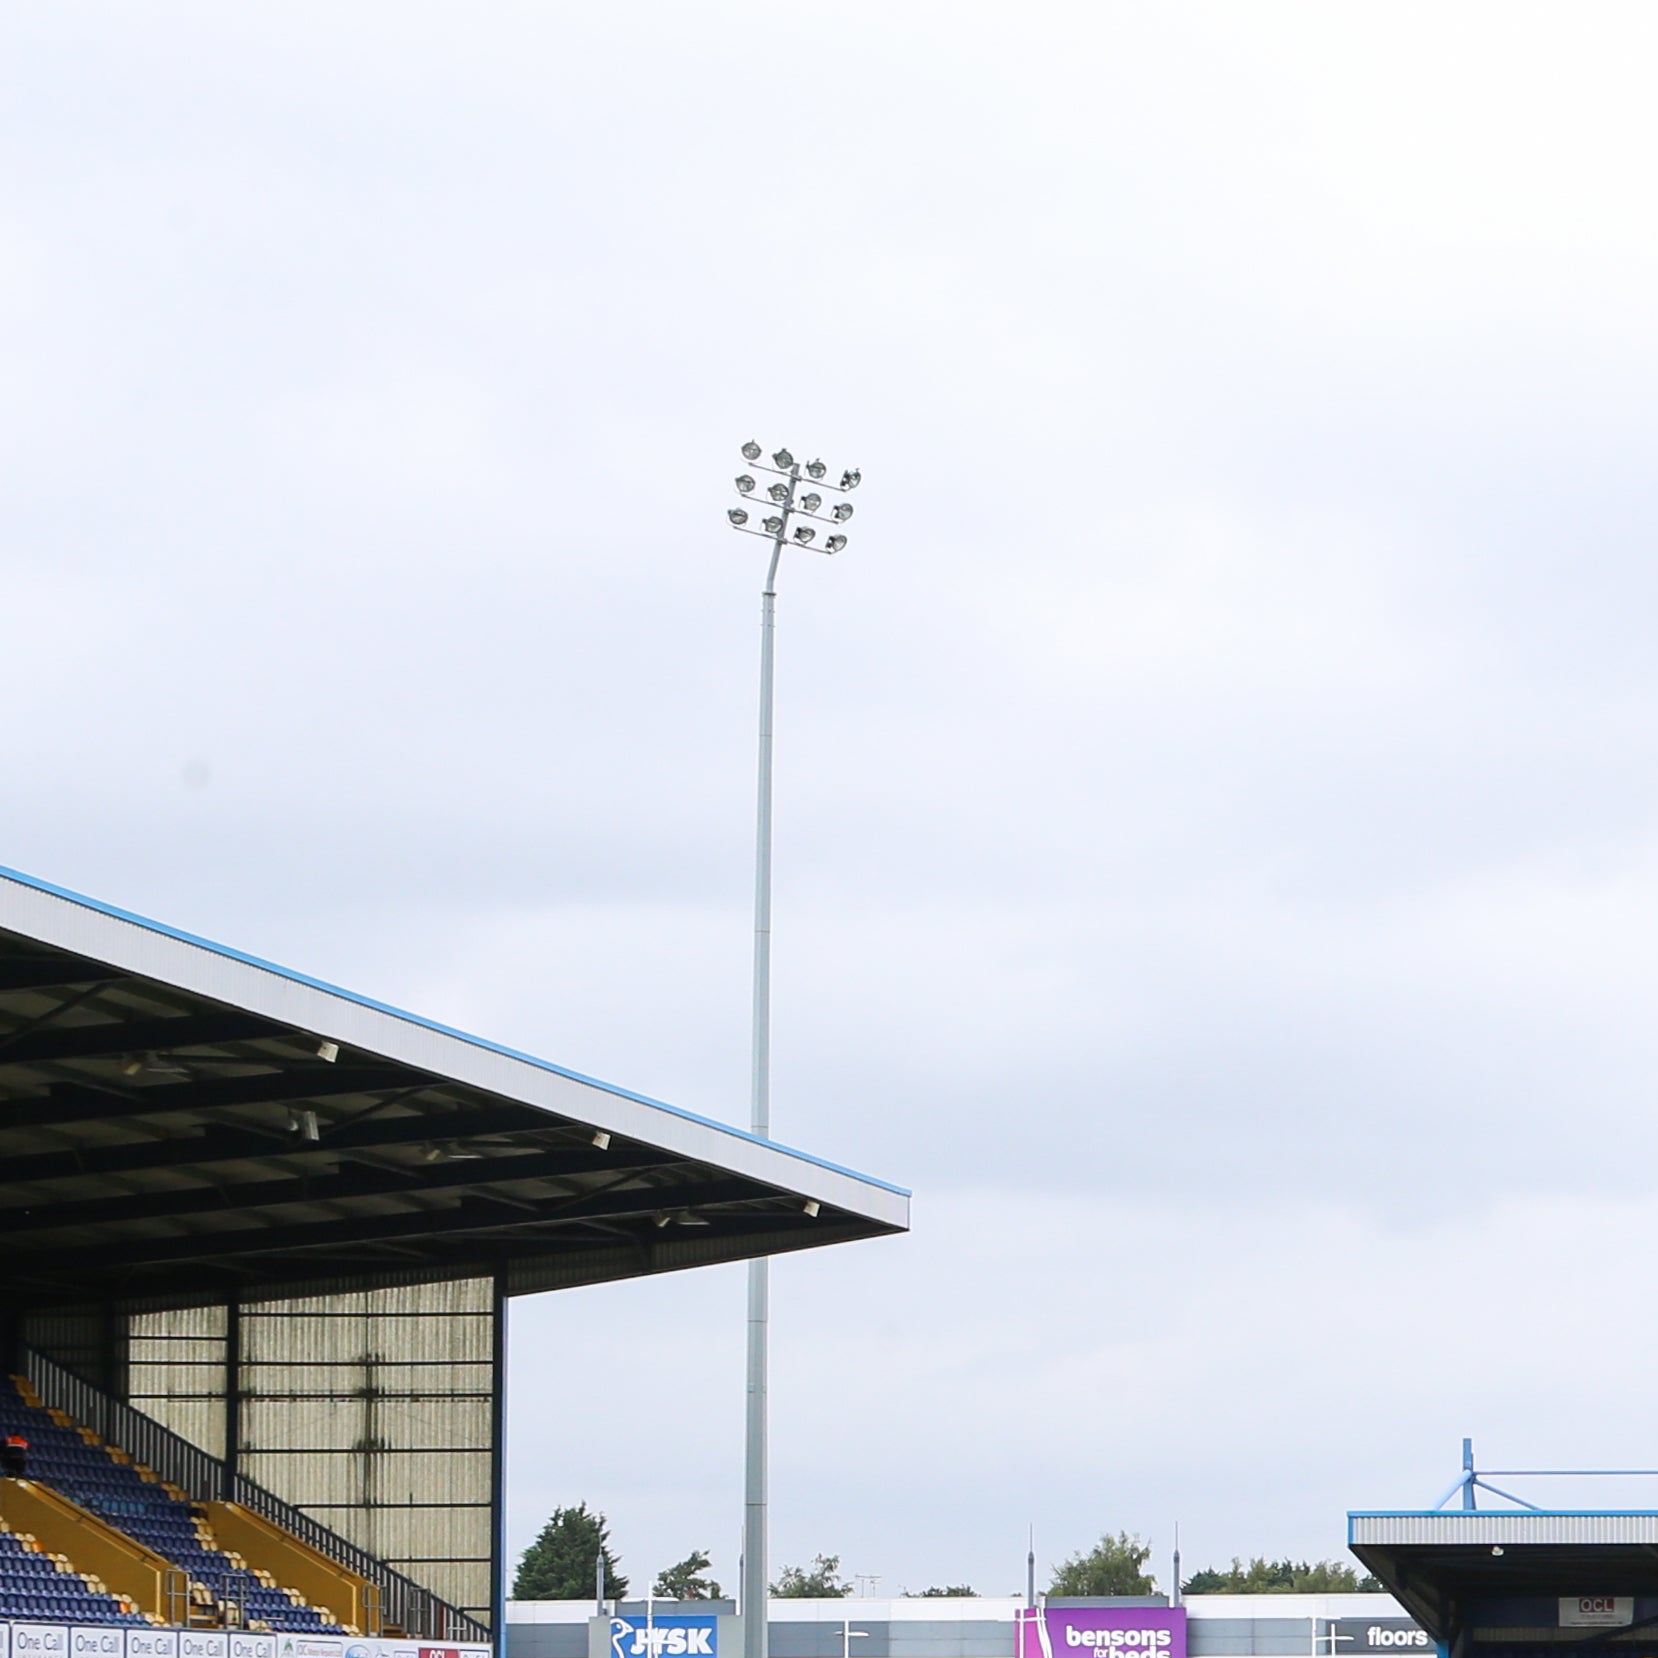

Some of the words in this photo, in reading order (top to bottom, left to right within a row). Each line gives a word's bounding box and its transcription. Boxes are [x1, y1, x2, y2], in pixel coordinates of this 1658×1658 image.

[17, 1632, 41, 1650] One
[44, 1633, 63, 1651] Call
[75, 1634, 97, 1653] One
[100, 1635, 120, 1653] Call
[630, 1627, 714, 1655] JYSK
[1065, 1625, 1172, 1647] bensons
[1367, 1626, 1429, 1646] floors
[131, 1637, 152, 1655] One
[154, 1638, 173, 1656] Call
[184, 1639, 203, 1656] One
[206, 1640, 224, 1657] Call
[234, 1641, 252, 1657] One
[255, 1642, 273, 1658] Call
